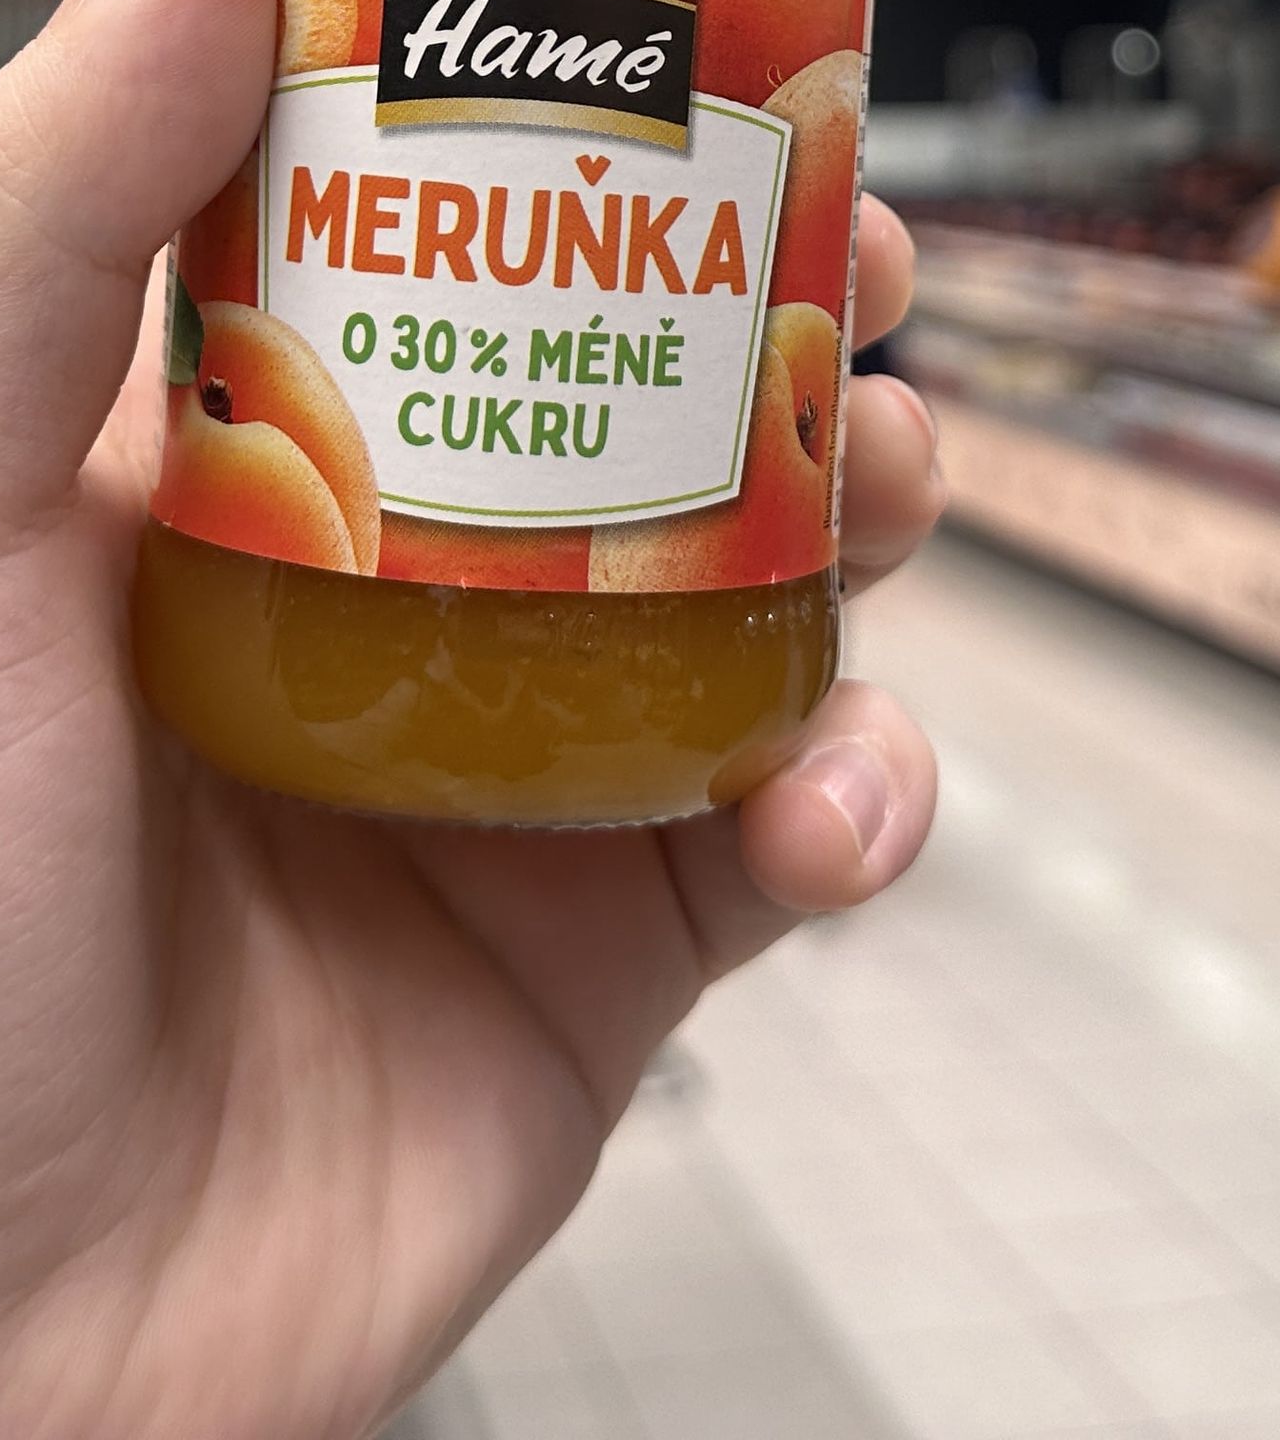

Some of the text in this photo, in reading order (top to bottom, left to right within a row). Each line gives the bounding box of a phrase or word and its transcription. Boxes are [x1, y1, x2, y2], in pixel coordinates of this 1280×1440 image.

[285, 154, 748, 297] MERUŇKA
[527, 315, 686, 387] MÉNĚ
[397, 391, 610, 459] CUKRU
